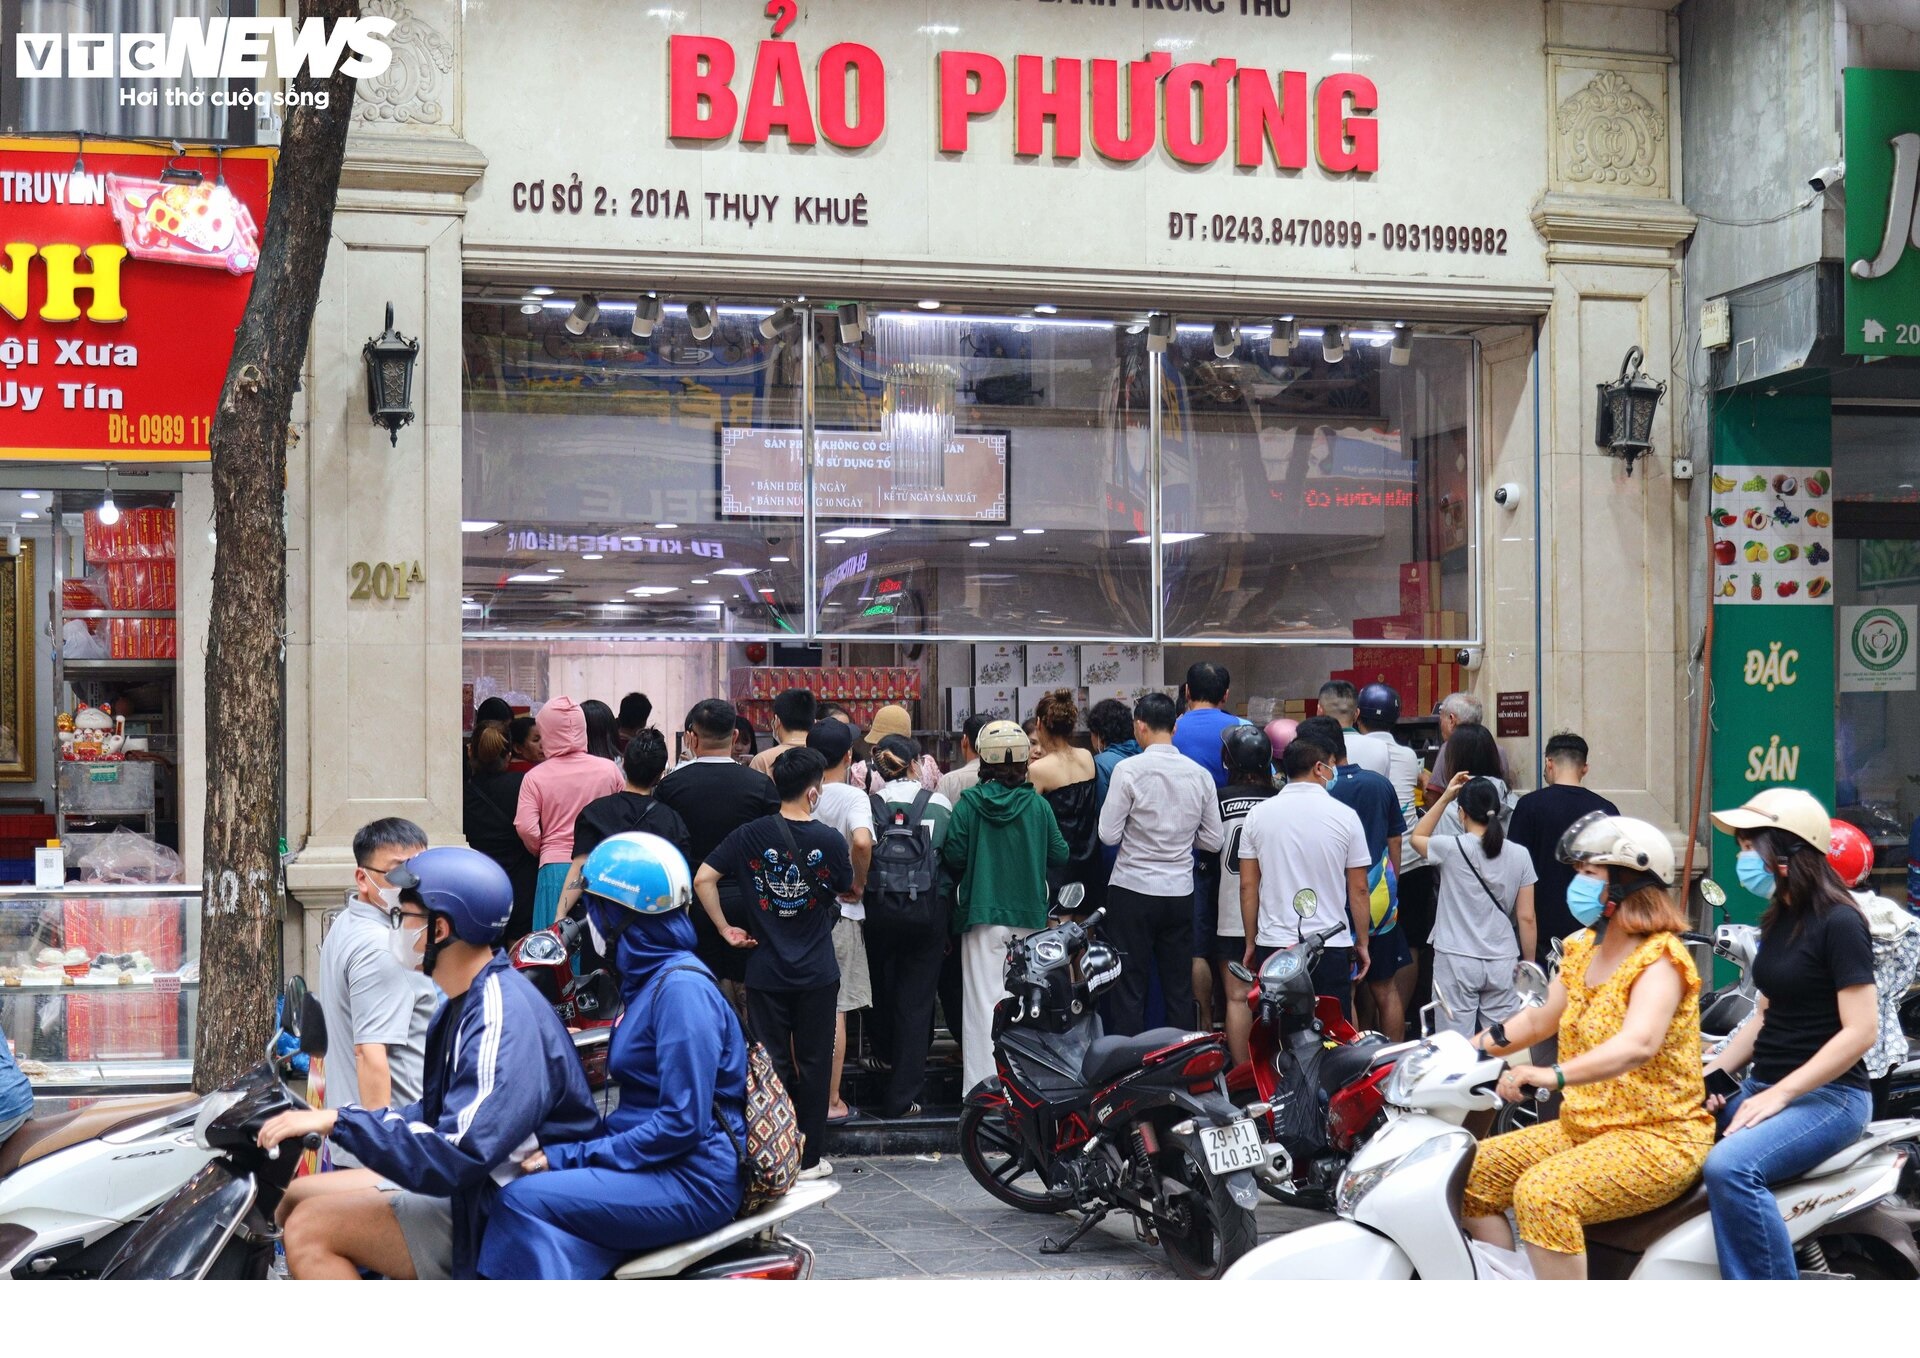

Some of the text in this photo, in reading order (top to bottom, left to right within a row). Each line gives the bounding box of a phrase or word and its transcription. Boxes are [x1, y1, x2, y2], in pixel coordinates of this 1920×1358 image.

[667, 0, 1379, 174] BẢO PHƯƠNG
[513, 180, 545, 213] CƠ
[552, 172, 583, 215] SỞ
[631, 188, 691, 219] 201A
[704, 192, 780, 228] THỤY
[795, 193, 870, 225] KHUÊ
[1382, 222, 1509, 255] 0931999982
[54, 338, 138, 366] Xưa
[57, 382, 123, 410] Tín
[139, 414, 185, 444] 0989
[763, 436, 786, 448] SẢN
[821, 439, 860, 450] KHÔNG
[862, 440, 876, 451] CÓ
[844, 457, 874, 469] DỤNG
[757, 480, 784, 491] BÁNH
[820, 481, 847, 492] NGÀY
[910, 491, 936, 502] NGÀY
[955, 492, 978, 503] XUẤT
[757, 495, 784, 506] BÁNH
[836, 496, 864, 508] NGÀY
[1744, 641, 1799, 692] ĐẶC
[1744, 735, 1799, 782] SẢN
[1209, 1124, 1250, 1150] 29-P1
[111, 1149, 175, 1161] LEAD
[1210, 1144, 1261, 1171] 740.35
